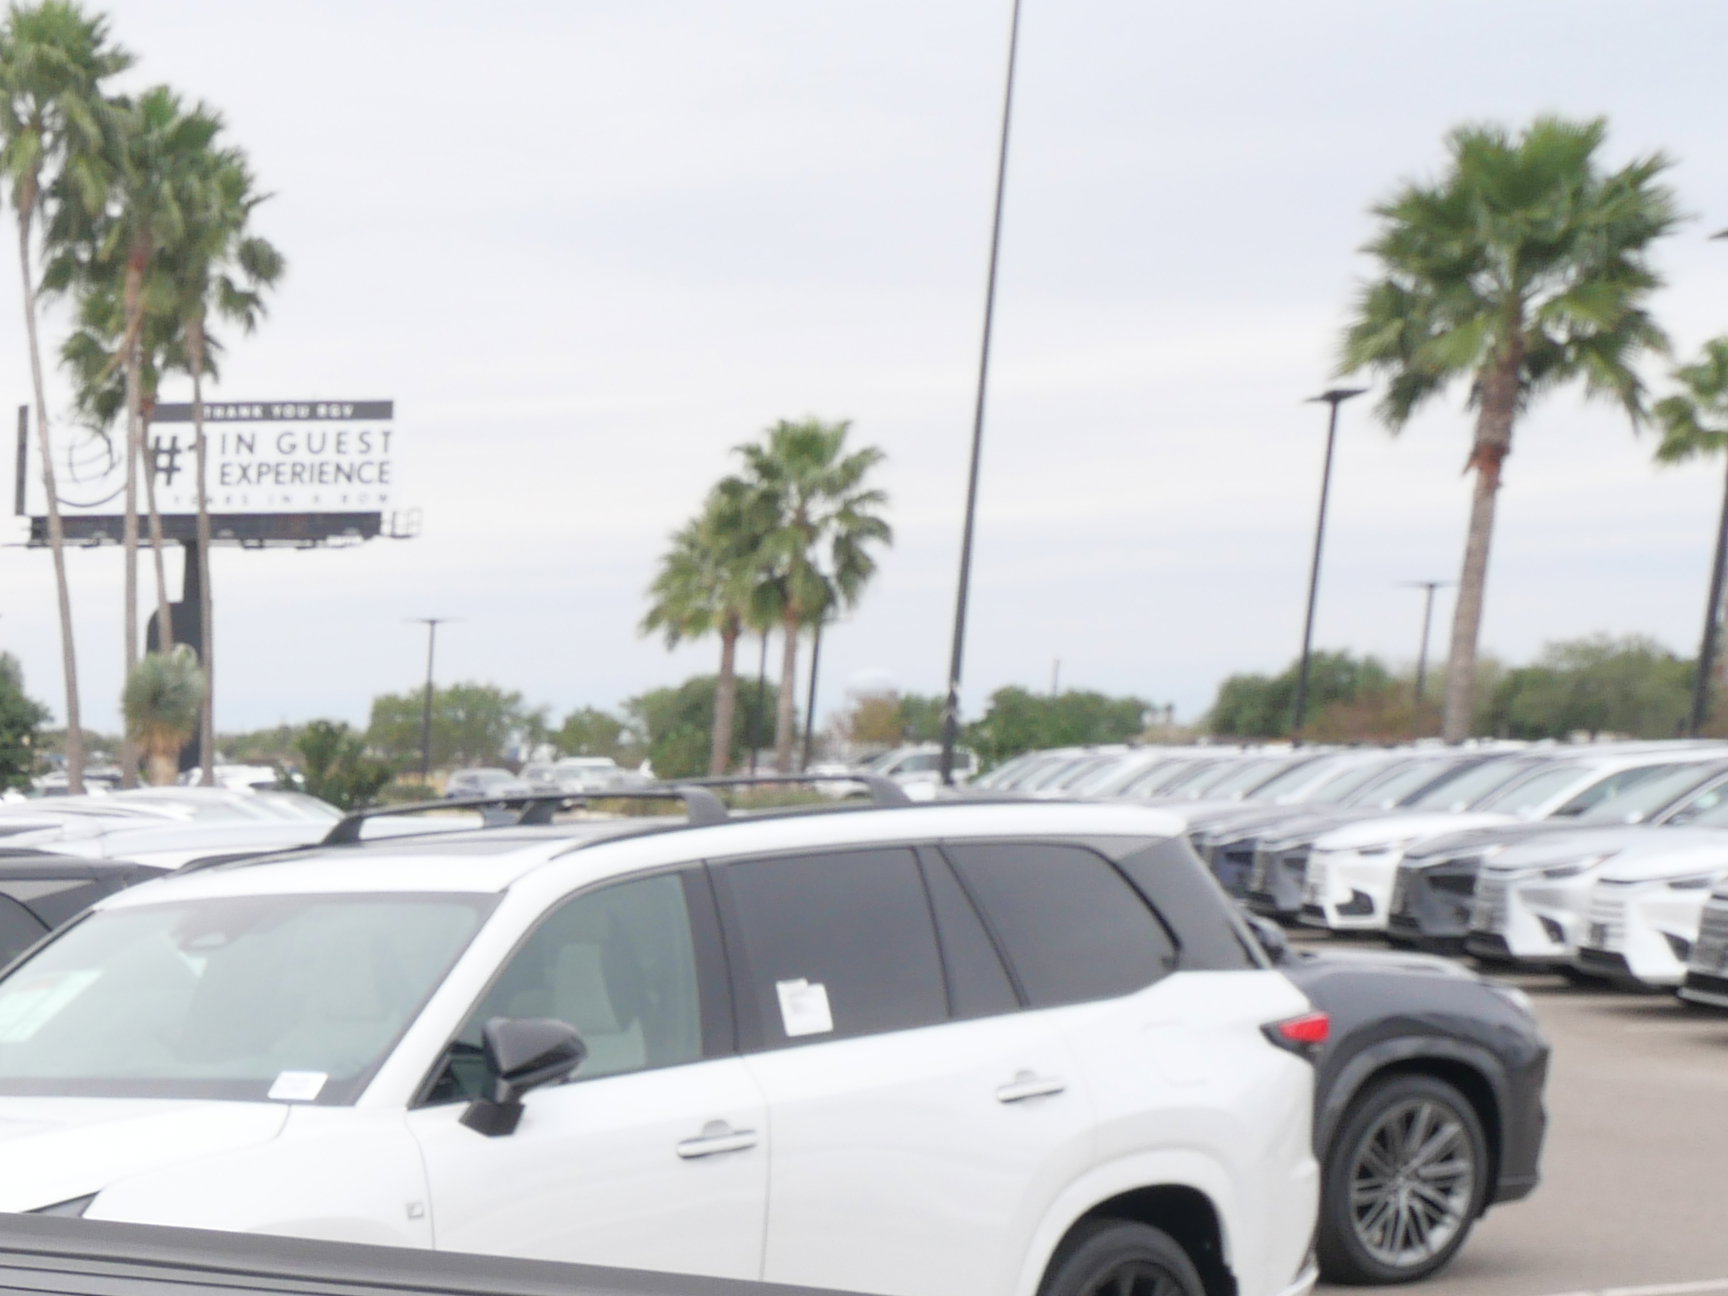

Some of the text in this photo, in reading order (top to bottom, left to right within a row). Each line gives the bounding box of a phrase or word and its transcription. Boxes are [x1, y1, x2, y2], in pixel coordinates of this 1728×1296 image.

[202, 404, 263, 419] THANK
[271, 404, 310, 419] YOU
[221, 431, 391, 455] IN GUEST
[220, 461, 390, 486] EXPERIENCE
